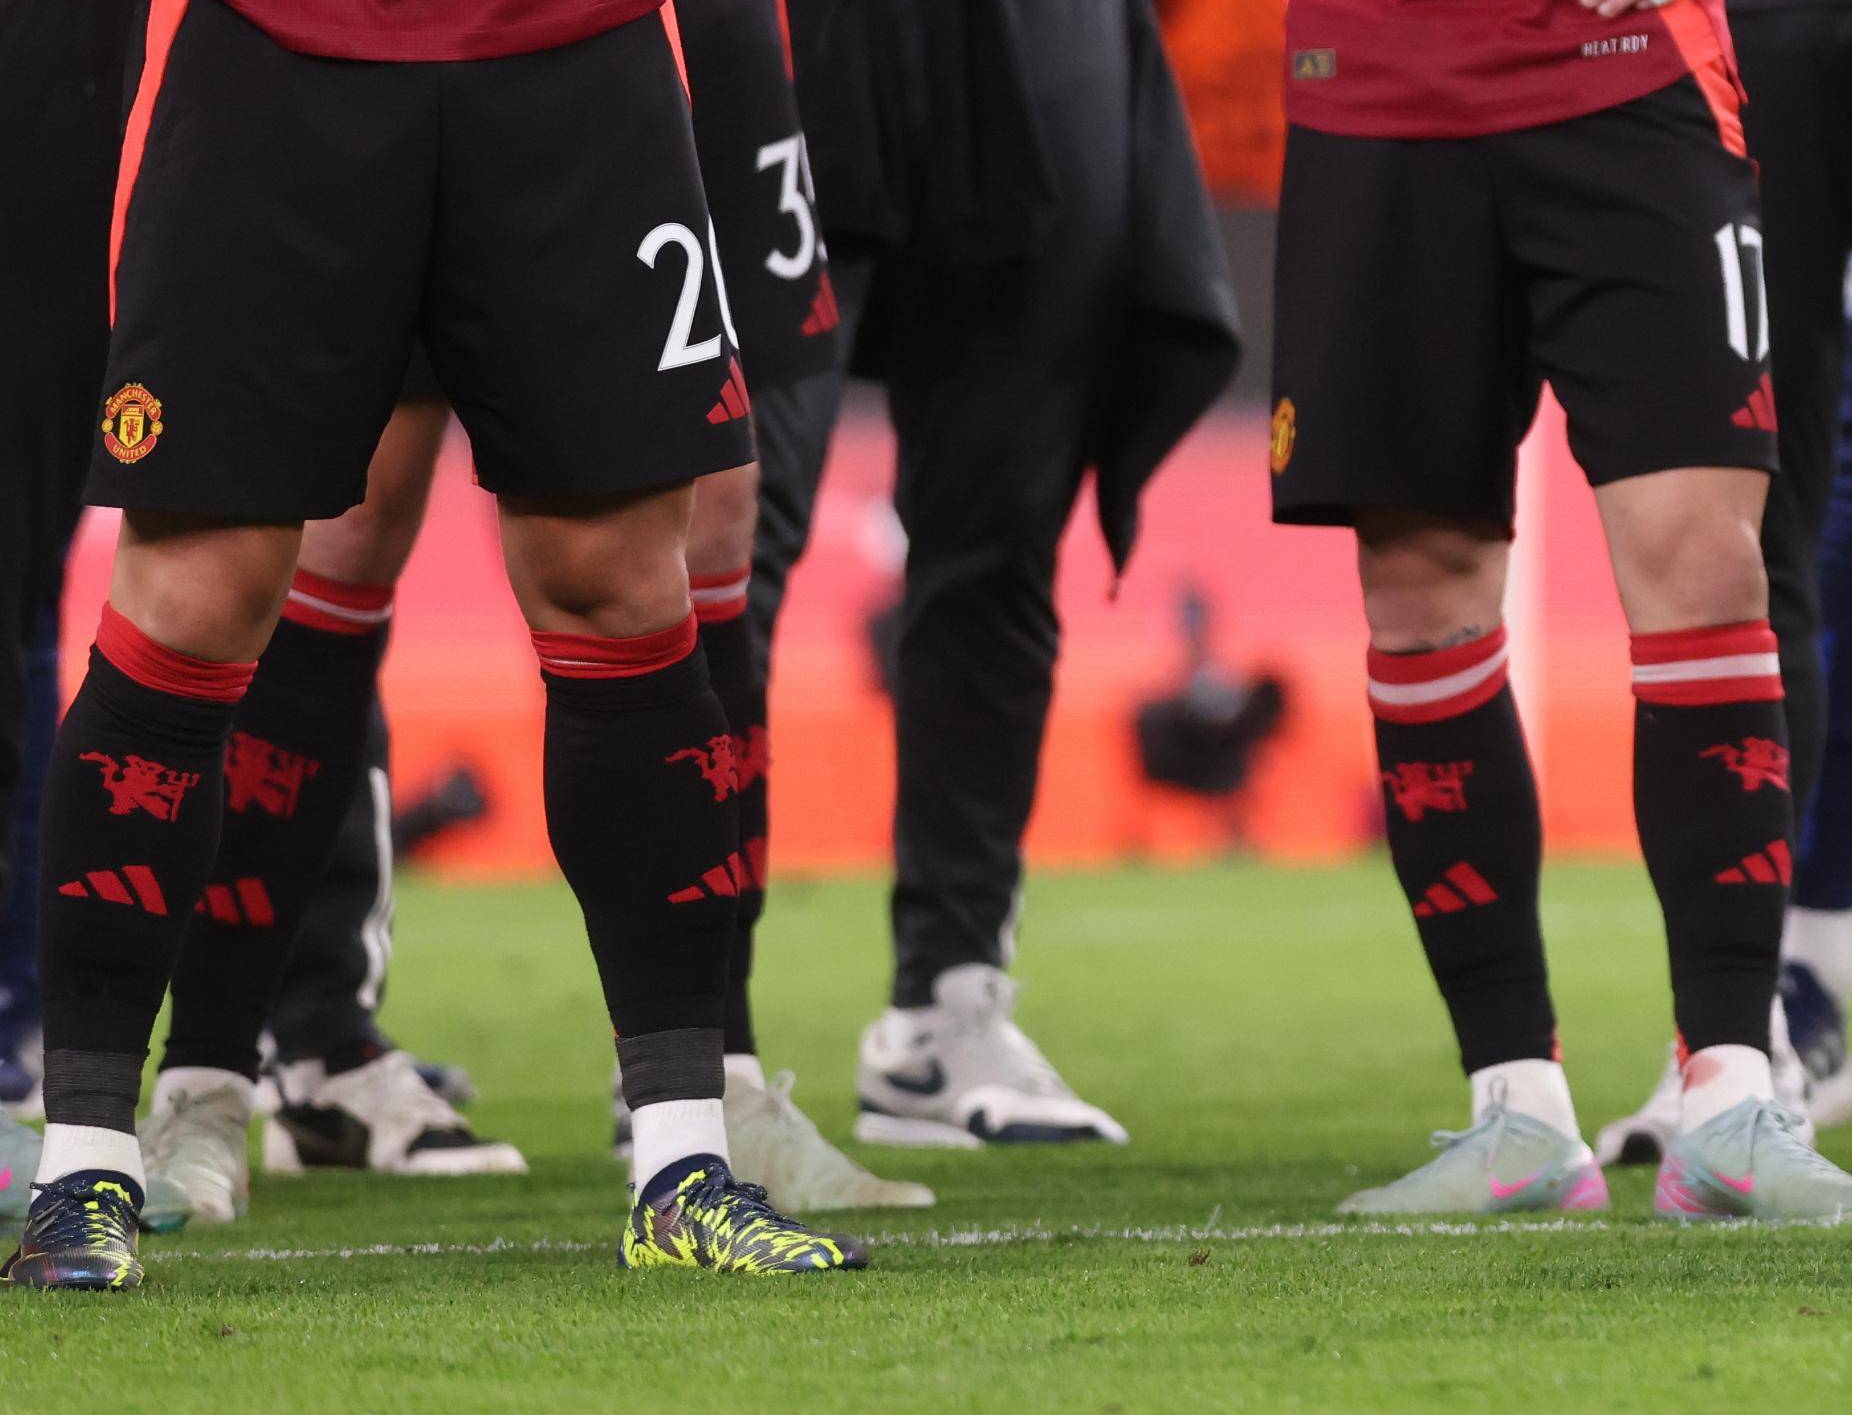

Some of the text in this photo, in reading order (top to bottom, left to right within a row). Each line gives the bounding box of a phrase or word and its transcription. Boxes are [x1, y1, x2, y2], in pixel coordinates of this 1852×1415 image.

[755, 130, 828, 281] 3
[636, 213, 740, 372] 2
[110, 388, 158, 416] MANCHESTER
[112, 443, 148, 459] UNITED
